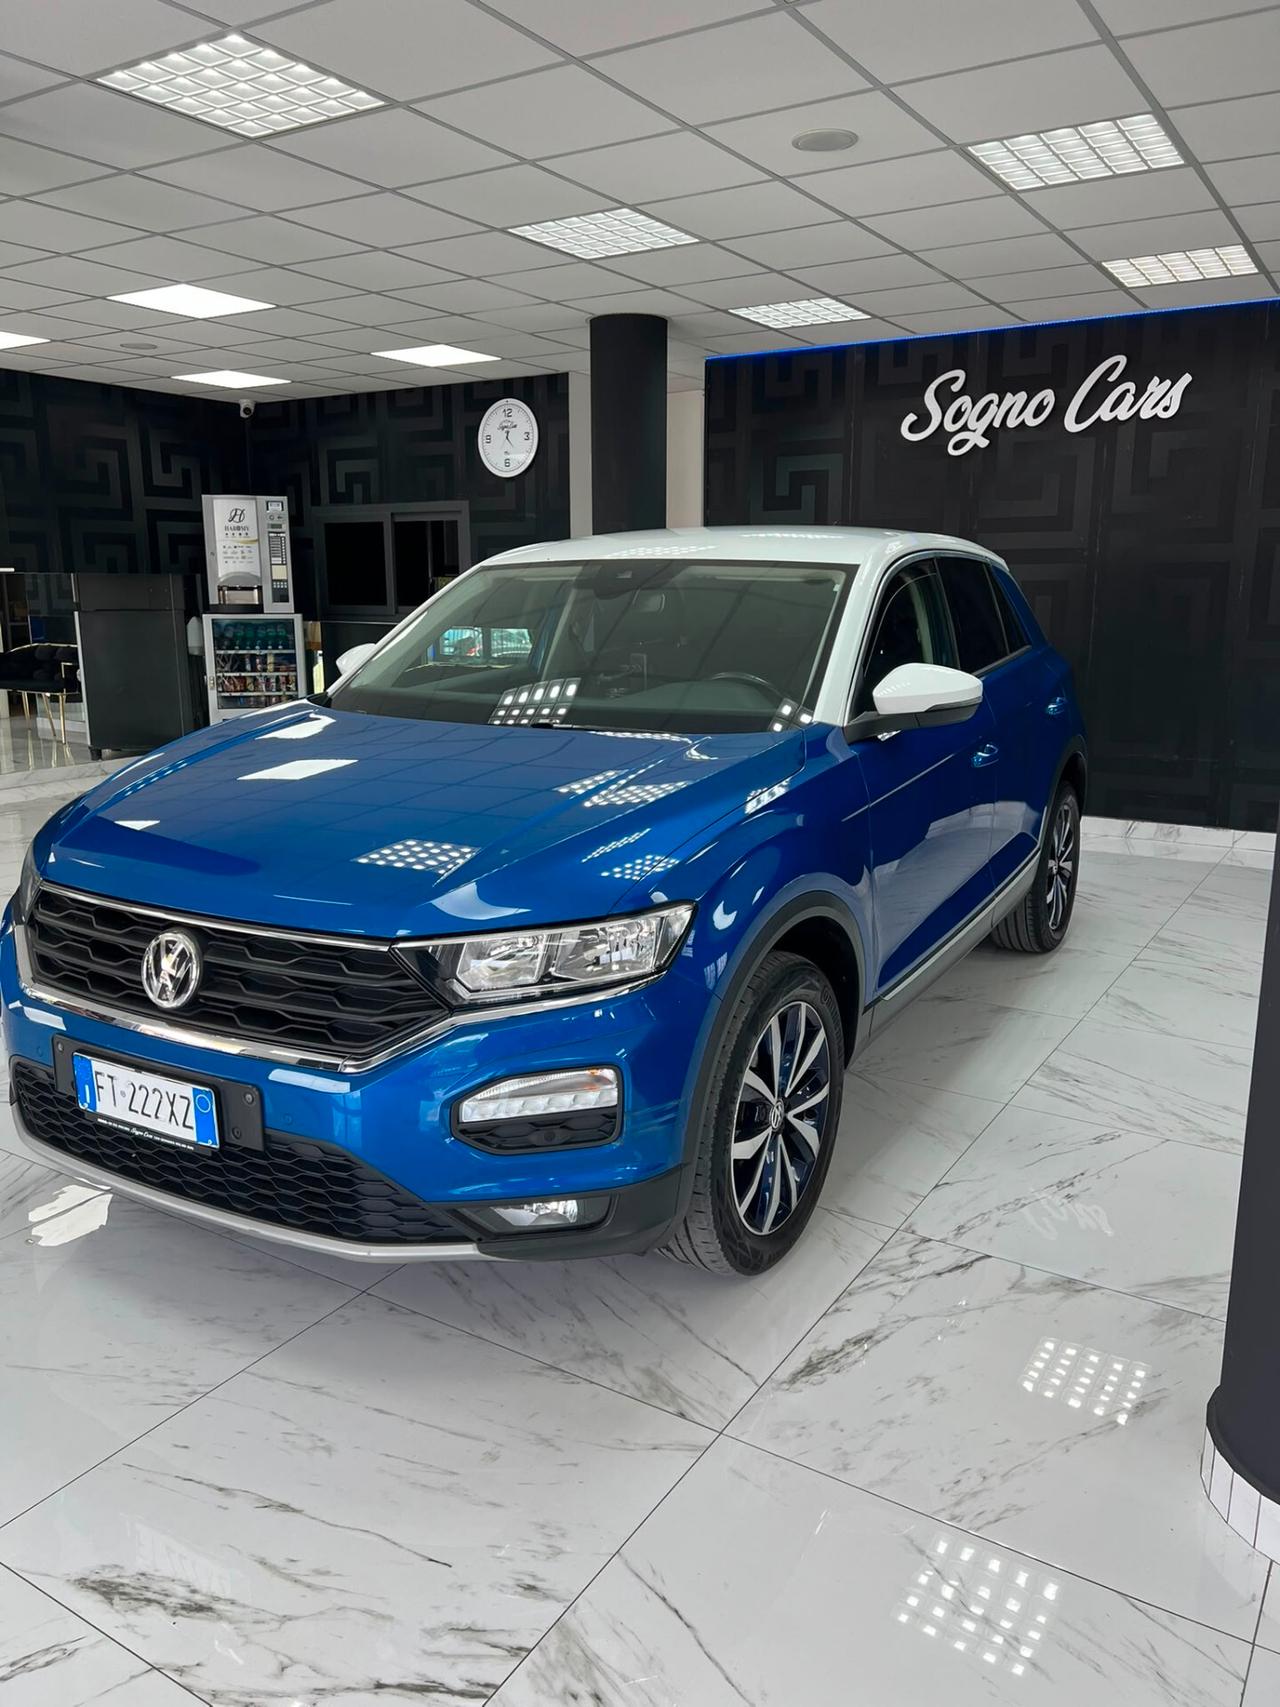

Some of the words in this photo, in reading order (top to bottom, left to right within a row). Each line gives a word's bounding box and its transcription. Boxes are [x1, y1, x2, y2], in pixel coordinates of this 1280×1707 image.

[901, 369, 1056, 456] Sogno
[1064, 355, 1192, 433] Cars
[503, 408, 512, 417] 12
[486, 435, 492, 444] 9
[524, 432, 530, 441] 3
[504, 459, 511, 468] 6
